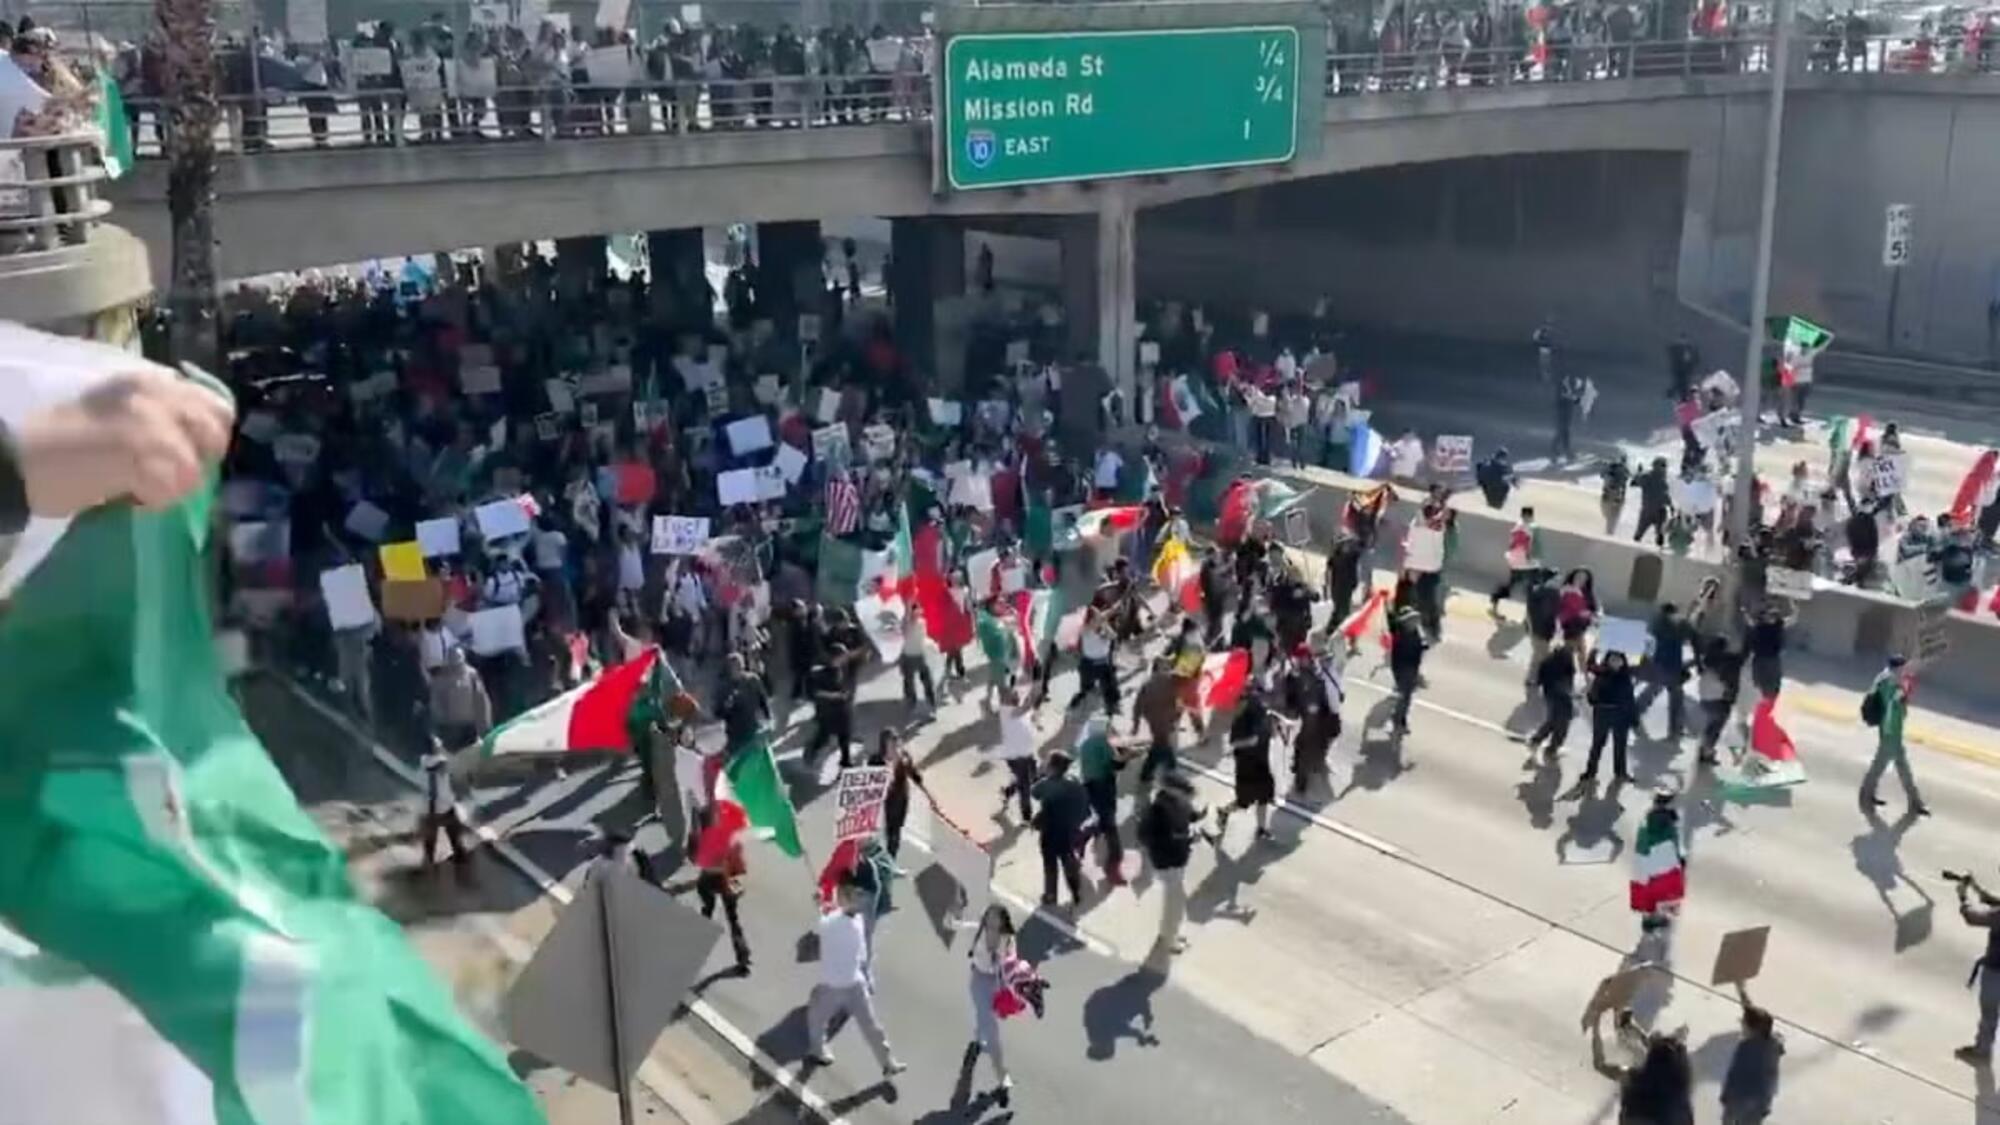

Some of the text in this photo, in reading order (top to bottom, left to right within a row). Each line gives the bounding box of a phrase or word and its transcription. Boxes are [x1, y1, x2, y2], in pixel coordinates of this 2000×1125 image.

[965, 57, 1067, 81] Alameda
[1080, 54, 1104, 77] St
[965, 75, 1283, 121] Mission Rd 3/4
[973, 118, 1250, 161] 10 EAST 1
